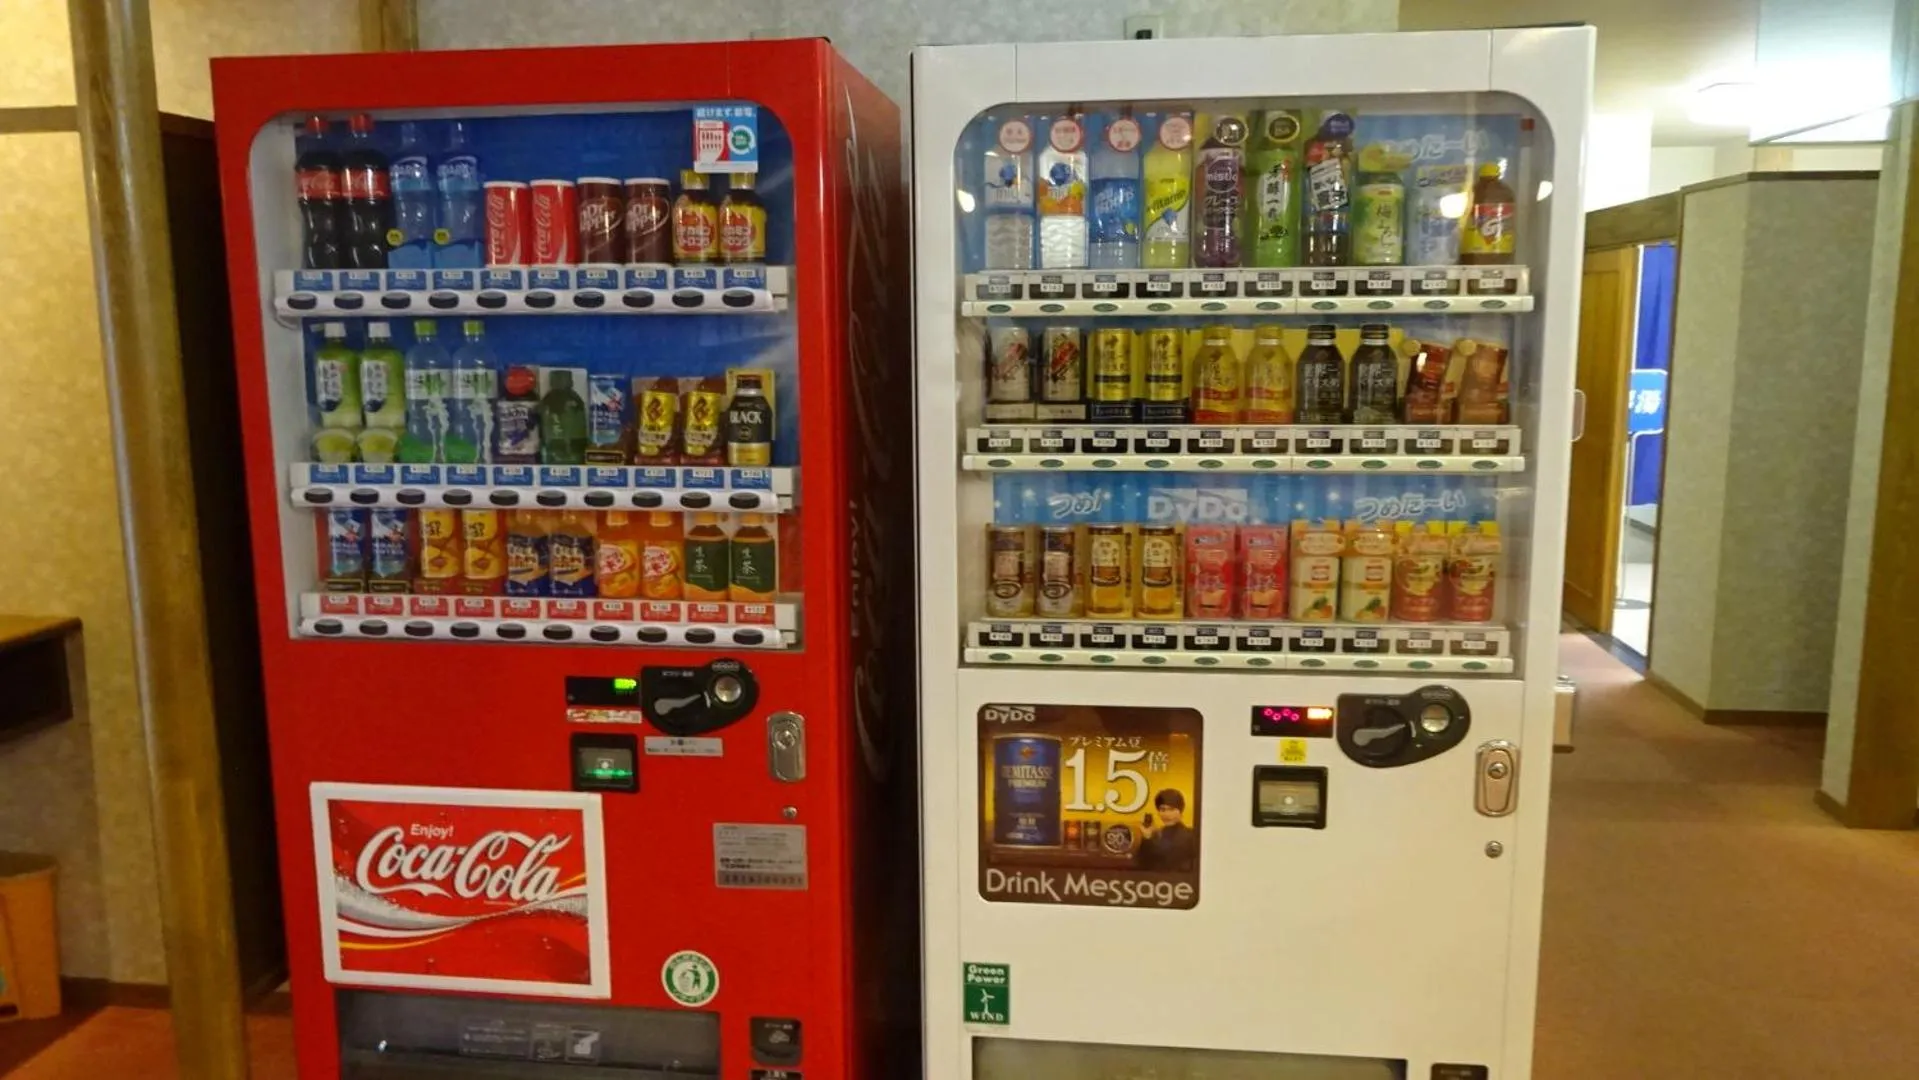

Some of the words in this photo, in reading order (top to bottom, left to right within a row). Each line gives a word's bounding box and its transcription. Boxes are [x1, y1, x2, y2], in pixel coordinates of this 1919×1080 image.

[730, 411, 762, 425] BLACK
[1148, 489, 1247, 521] DyDo
[985, 706, 1035, 724] DyDo
[410, 823, 455, 839] Enjoy!
[356, 826, 572, 902] Coca-Cola
[986, 868, 1061, 902] Drink
[1064, 872, 1193, 905] Message
[968, 965, 1004, 975] Green
[967, 974, 1005, 983] Power
[970, 1011, 1004, 1021] WIND
